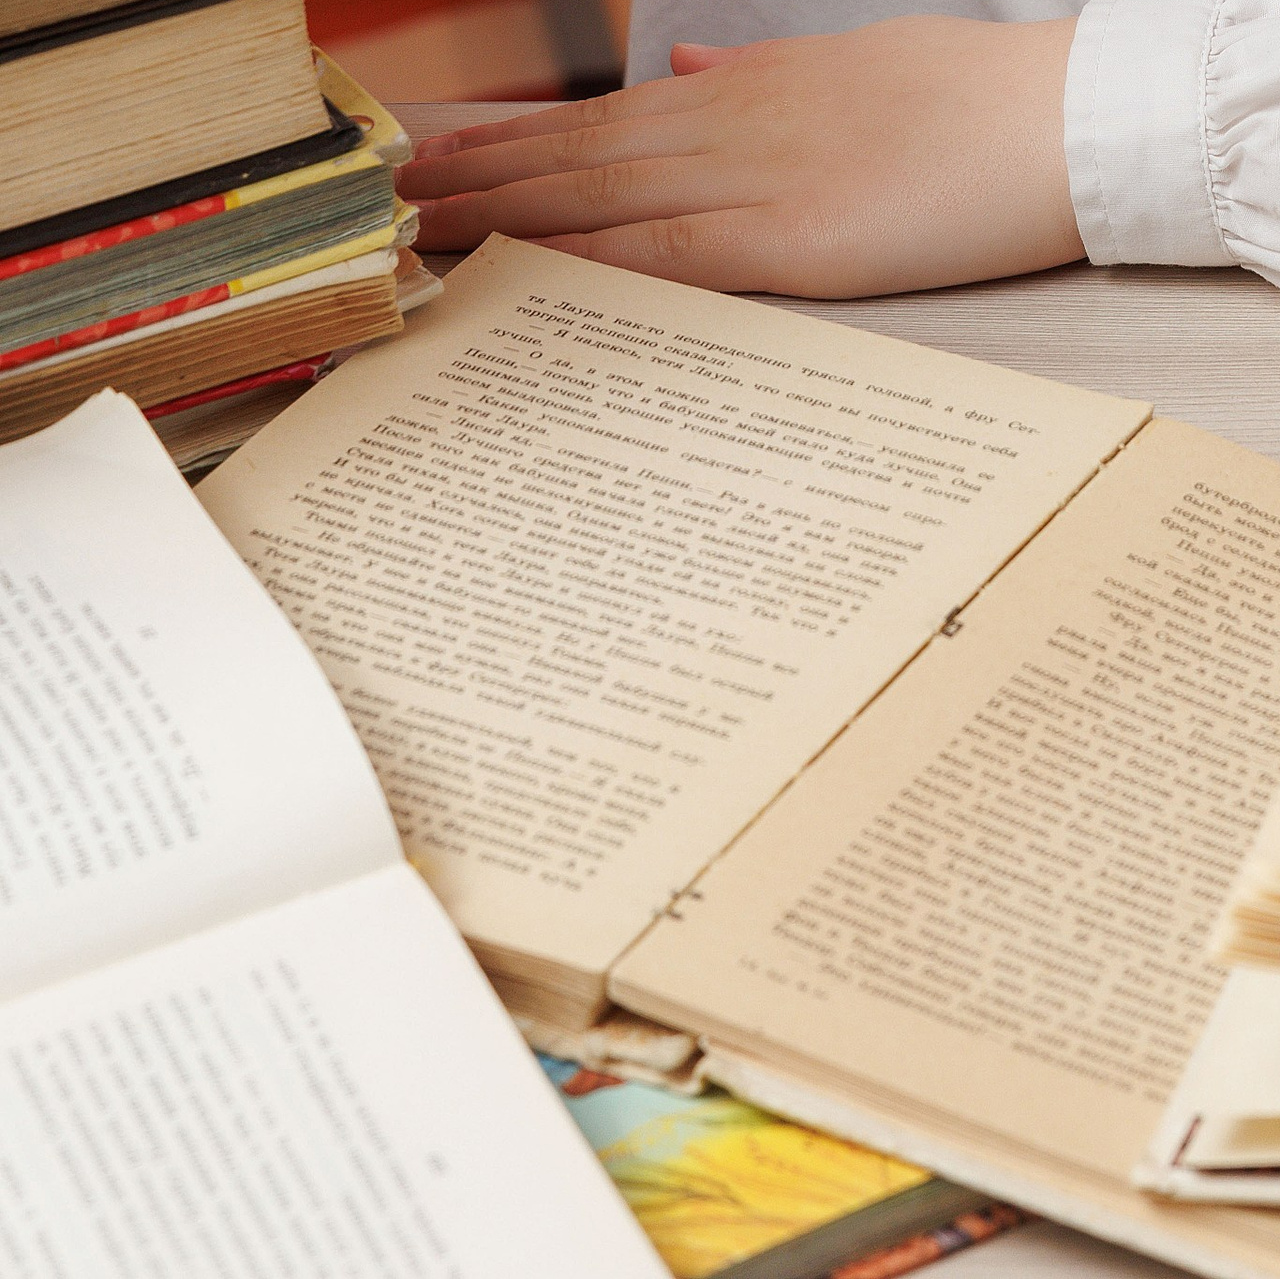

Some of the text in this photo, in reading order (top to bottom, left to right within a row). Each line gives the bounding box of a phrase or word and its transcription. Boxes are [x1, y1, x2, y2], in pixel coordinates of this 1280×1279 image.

[437, 371, 600, 420] совсем выздоровела.
[488, 327, 542, 346] лучше.
[515, 305, 733, 368] тергрен поспешно сказала:
[528, 294, 1039, 434] тя Лаура как-то неопределенно трясла головой, а фру Сет-
[552, 328, 1018, 458] Я надеюсь, тетя Лаура, что скоро вы почувствуете себя
[411, 393, 549, 436] сила тетя Лаура.
[450, 360, 971, 503] принимала очень хорошие успокаивающие средства и почти
[477, 394, 528, 413] Какие
[536, 413, 669, 452] успокаивающие
[804, 485, 890, 511] интересом
[902, 511, 944, 526] спро-
[528, 350, 543, 359] О
[549, 358, 573, 370] да,
[605, 372, 644, 387] этом
[653, 386, 710, 404] можно
[719, 403, 739, 412] не
[877, 445, 965, 473] успокоила
[977, 472, 995, 480] ее
[540, 369, 599, 390] потому
[607, 387, 634, 398] что
[639, 396, 651, 404] и
[658, 400, 728, 423] бабушке
[735, 422, 776, 436] моей
[782, 435, 828, 450] стало
[835, 448, 874, 463] куда
[883, 462, 938, 482] лучше.
[950, 477, 982, 492] Она
[1182, 493, 1222, 515] быть
